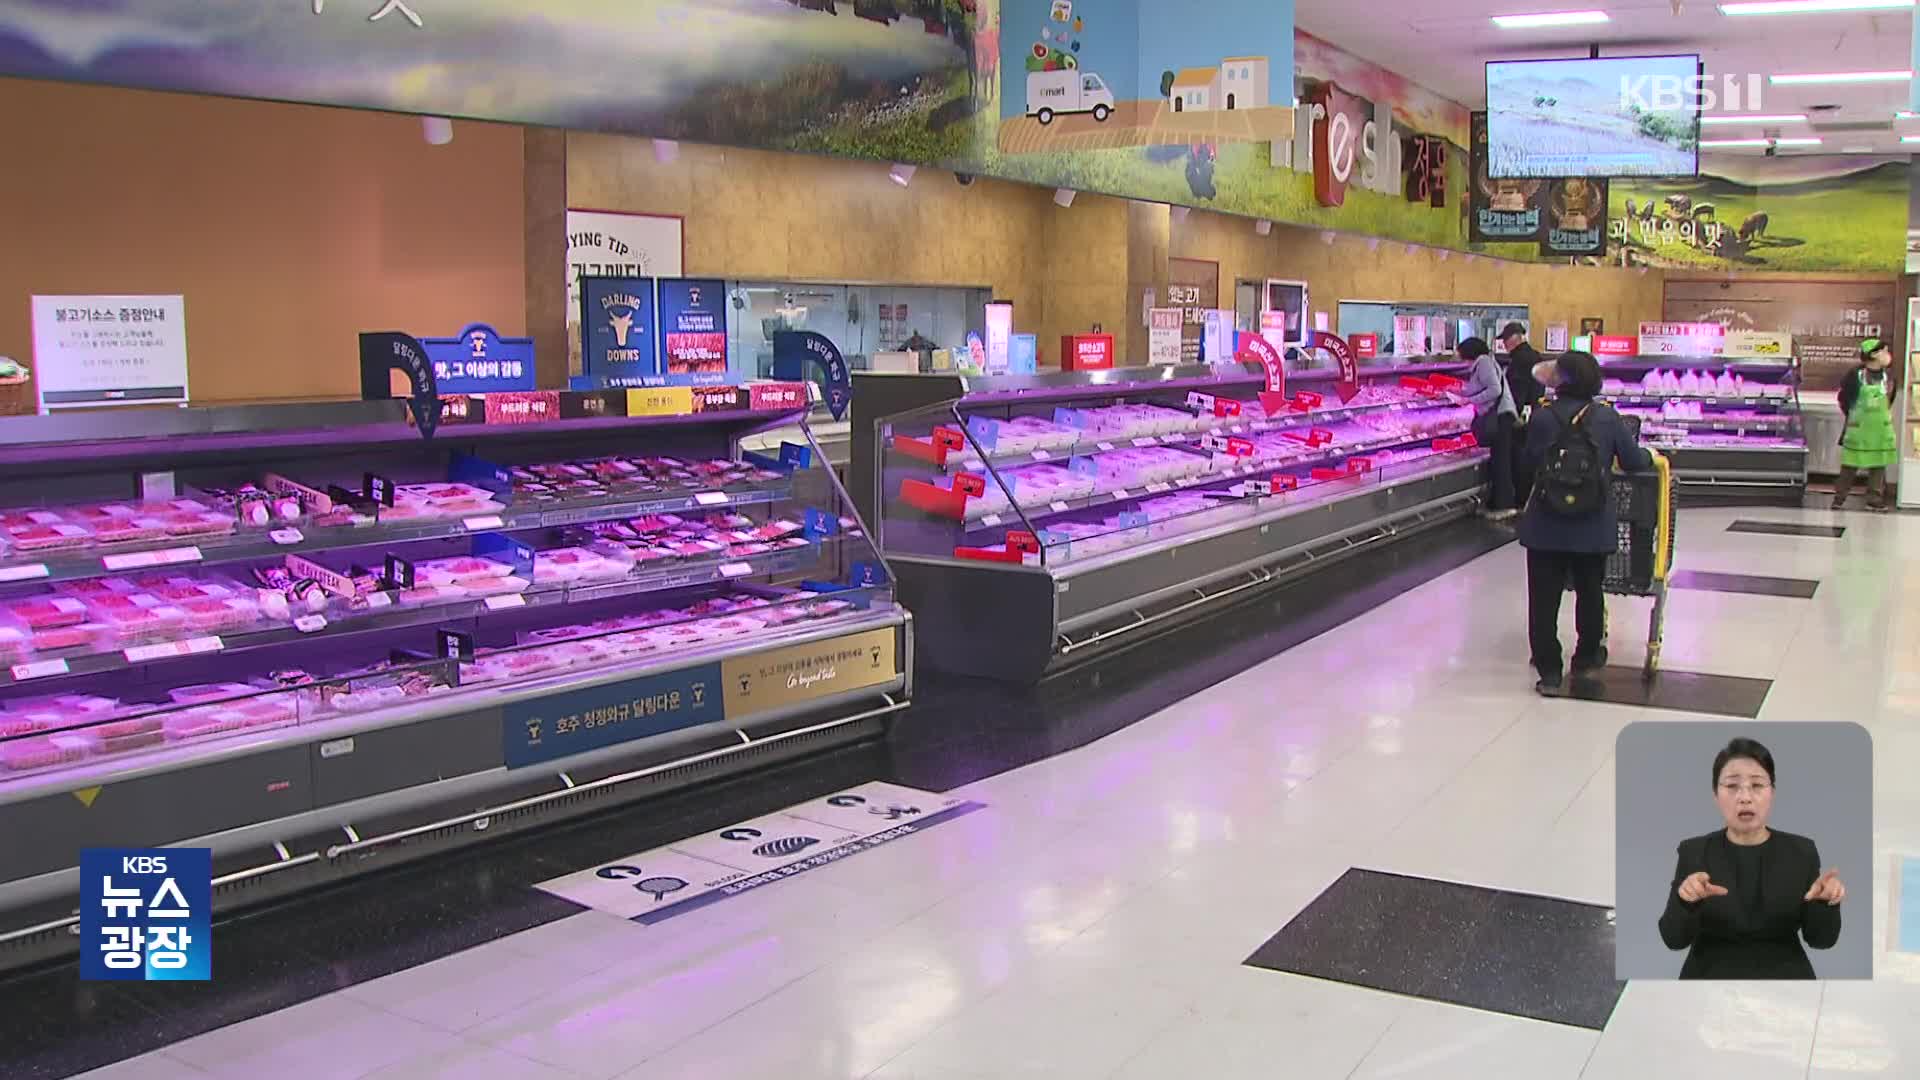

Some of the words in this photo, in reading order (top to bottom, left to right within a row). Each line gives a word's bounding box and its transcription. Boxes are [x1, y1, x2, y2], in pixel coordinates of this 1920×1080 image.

[569, 231, 602, 249] YING
[607, 237, 629, 256] TIP
[600, 293, 641, 310] DARLING
[55, 307, 116, 323] 불고기소스
[607, 349, 640, 363] DOWNS
[1248, 340, 1275, 363] 미국산
[1323, 338, 1347, 357] 미국산
[465, 360, 499, 379] 이상의
[555, 715, 581, 735] 호주
[583, 703, 630, 729] 청정와규
[632, 690, 681, 718] 달링다운
